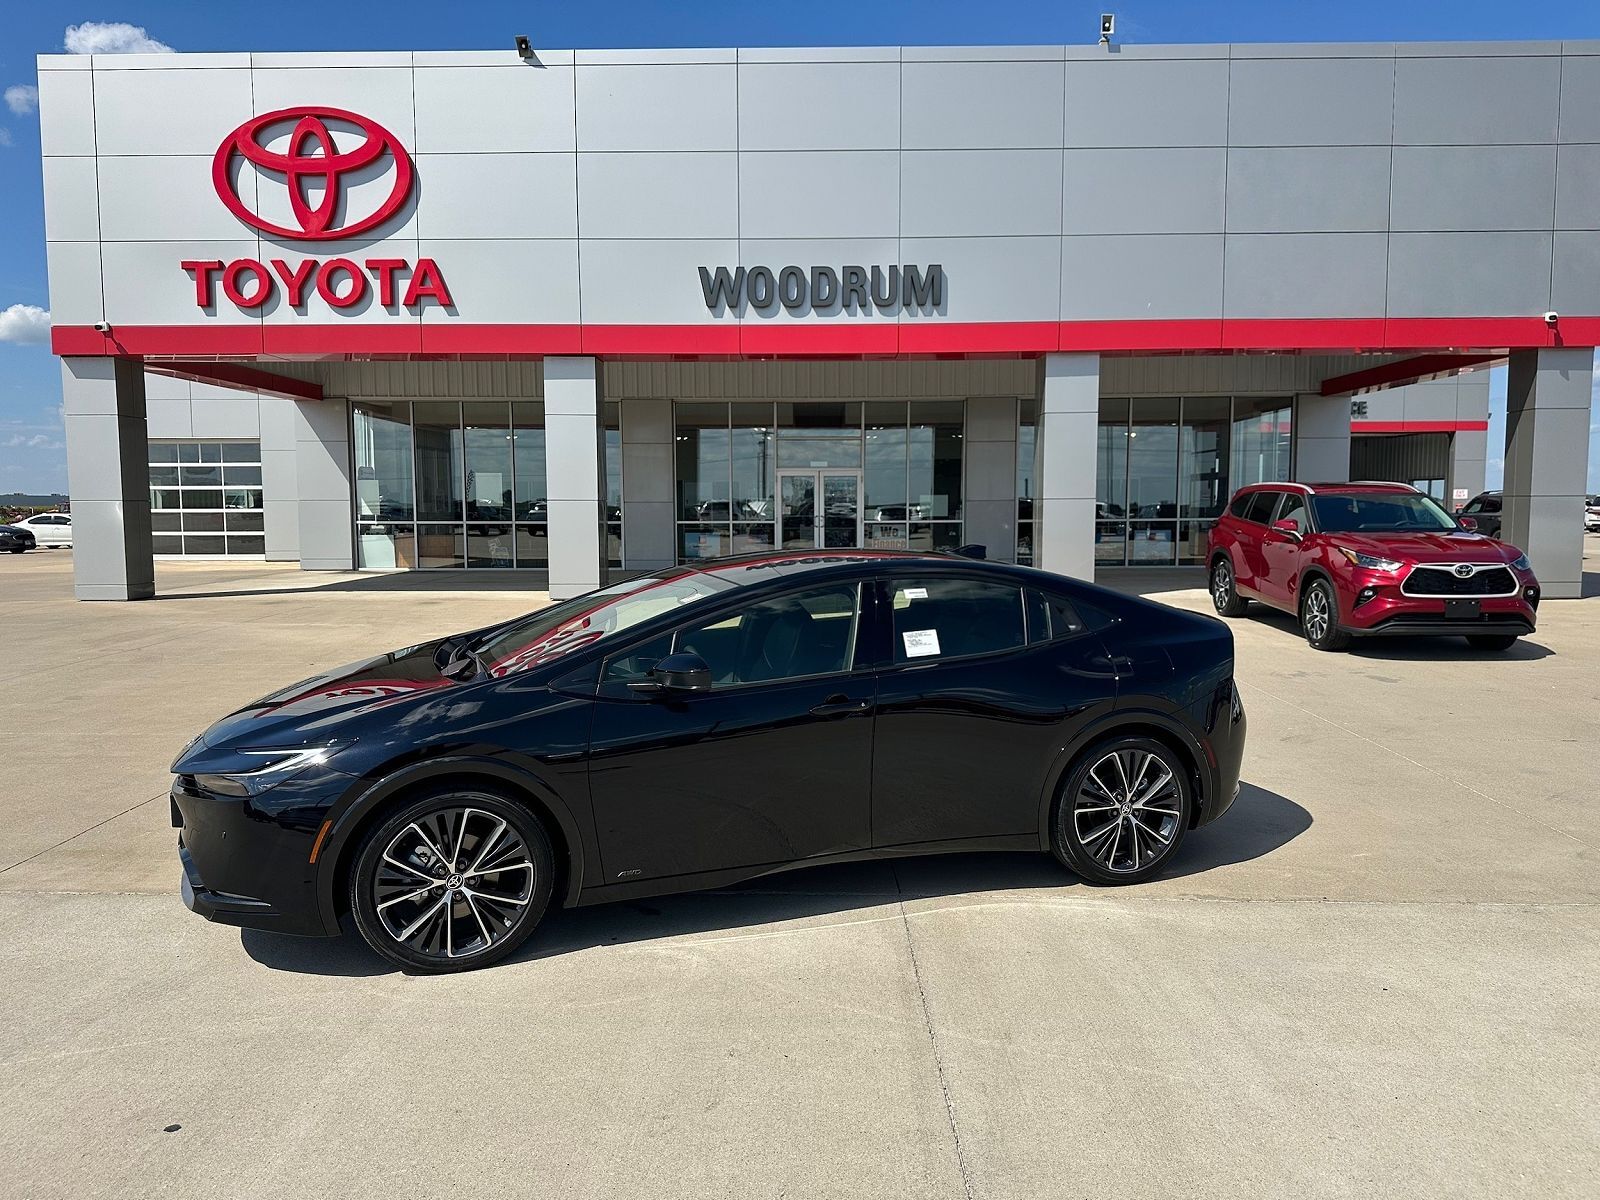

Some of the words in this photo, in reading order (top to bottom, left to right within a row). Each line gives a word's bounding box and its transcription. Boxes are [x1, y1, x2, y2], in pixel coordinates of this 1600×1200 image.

[181, 258, 452, 307] TOYOTA
[698, 265, 942, 308] WOODRUM
[880, 526, 899, 538] We
